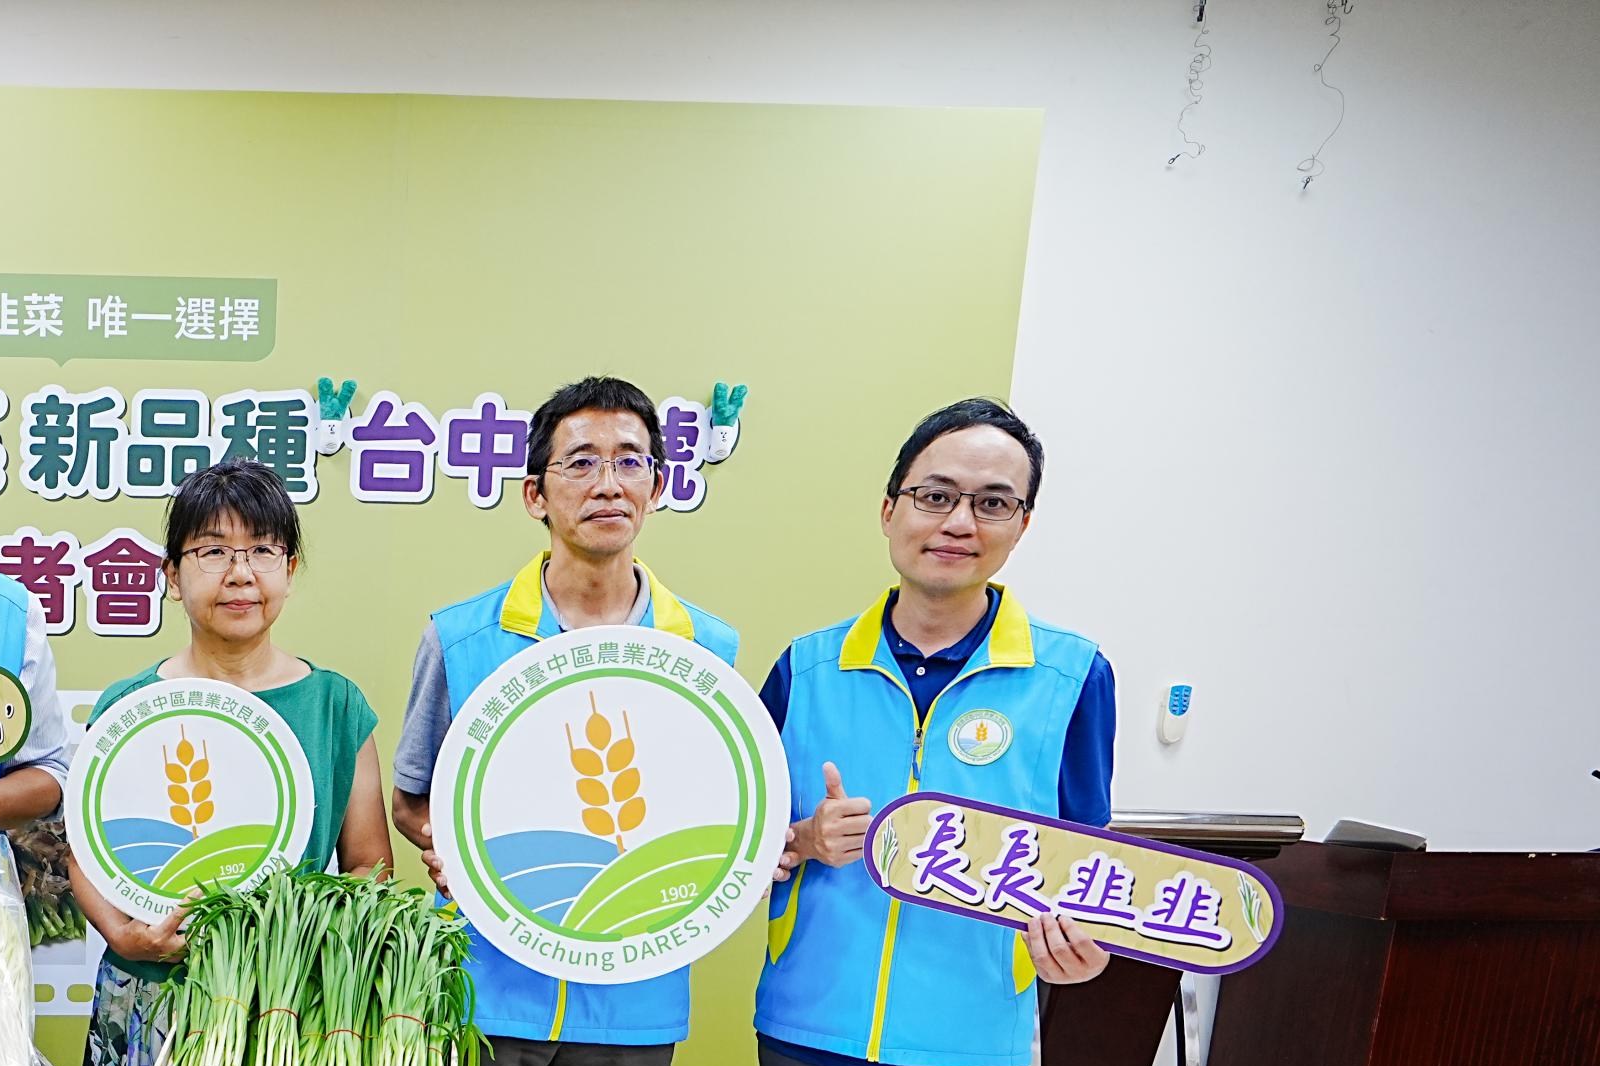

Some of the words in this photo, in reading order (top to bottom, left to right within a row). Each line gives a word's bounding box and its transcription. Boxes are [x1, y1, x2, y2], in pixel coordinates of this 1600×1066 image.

[86, 294, 261, 342] 唯一選擇
[352, 398, 700, 501] 台中
[95, 690, 270, 756] 農業部臺中區農業改良場
[468, 642, 719, 745] 農業部臺中區農業改良場
[114, 876, 176, 916] Taichun
[219, 862, 246, 876] 1902
[659, 882, 699, 904] 1902
[914, 809, 1226, 948] 長長韭韭
[509, 917, 615, 972] Taichung
[622, 918, 711, 965] DARES,
[706, 869, 753, 919] MOA
